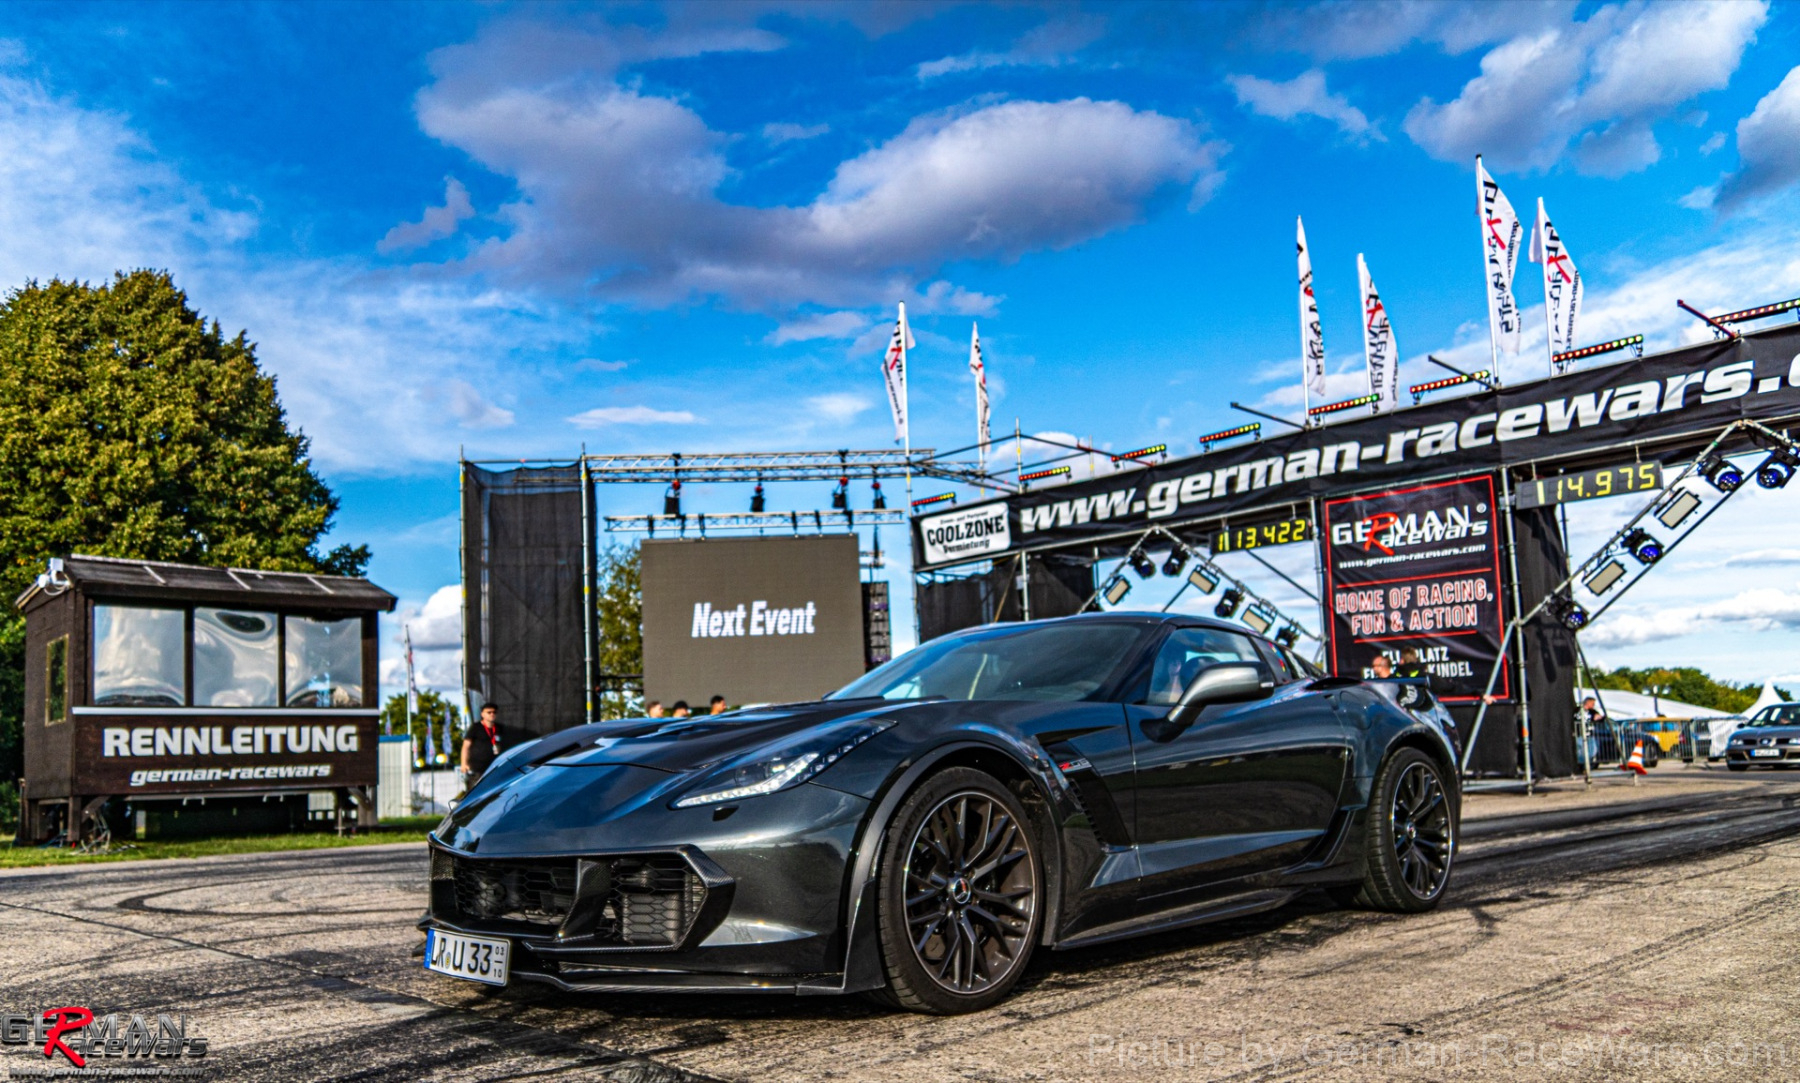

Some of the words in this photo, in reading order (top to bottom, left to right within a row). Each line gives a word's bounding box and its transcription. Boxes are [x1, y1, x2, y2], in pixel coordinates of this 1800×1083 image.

[1020, 353, 1800, 534] www.german-racewars.
[927, 515, 1005, 547] COOLZONE
[1339, 544, 1486, 569] www.german-racewars.com
[1336, 589, 1385, 614] HOME
[1389, 586, 1411, 609] OF
[1417, 578, 1493, 606] RACING,
[691, 602, 747, 638] Next
[749, 600, 817, 636] Event
[1352, 612, 1386, 636] FUN
[1390, 611, 1404, 632] &
[1409, 603, 1478, 631] ACTION
[103, 725, 359, 757] RENNLEITUNG
[130, 764, 331, 786] german-racewars
[467, 942, 493, 976] 33
